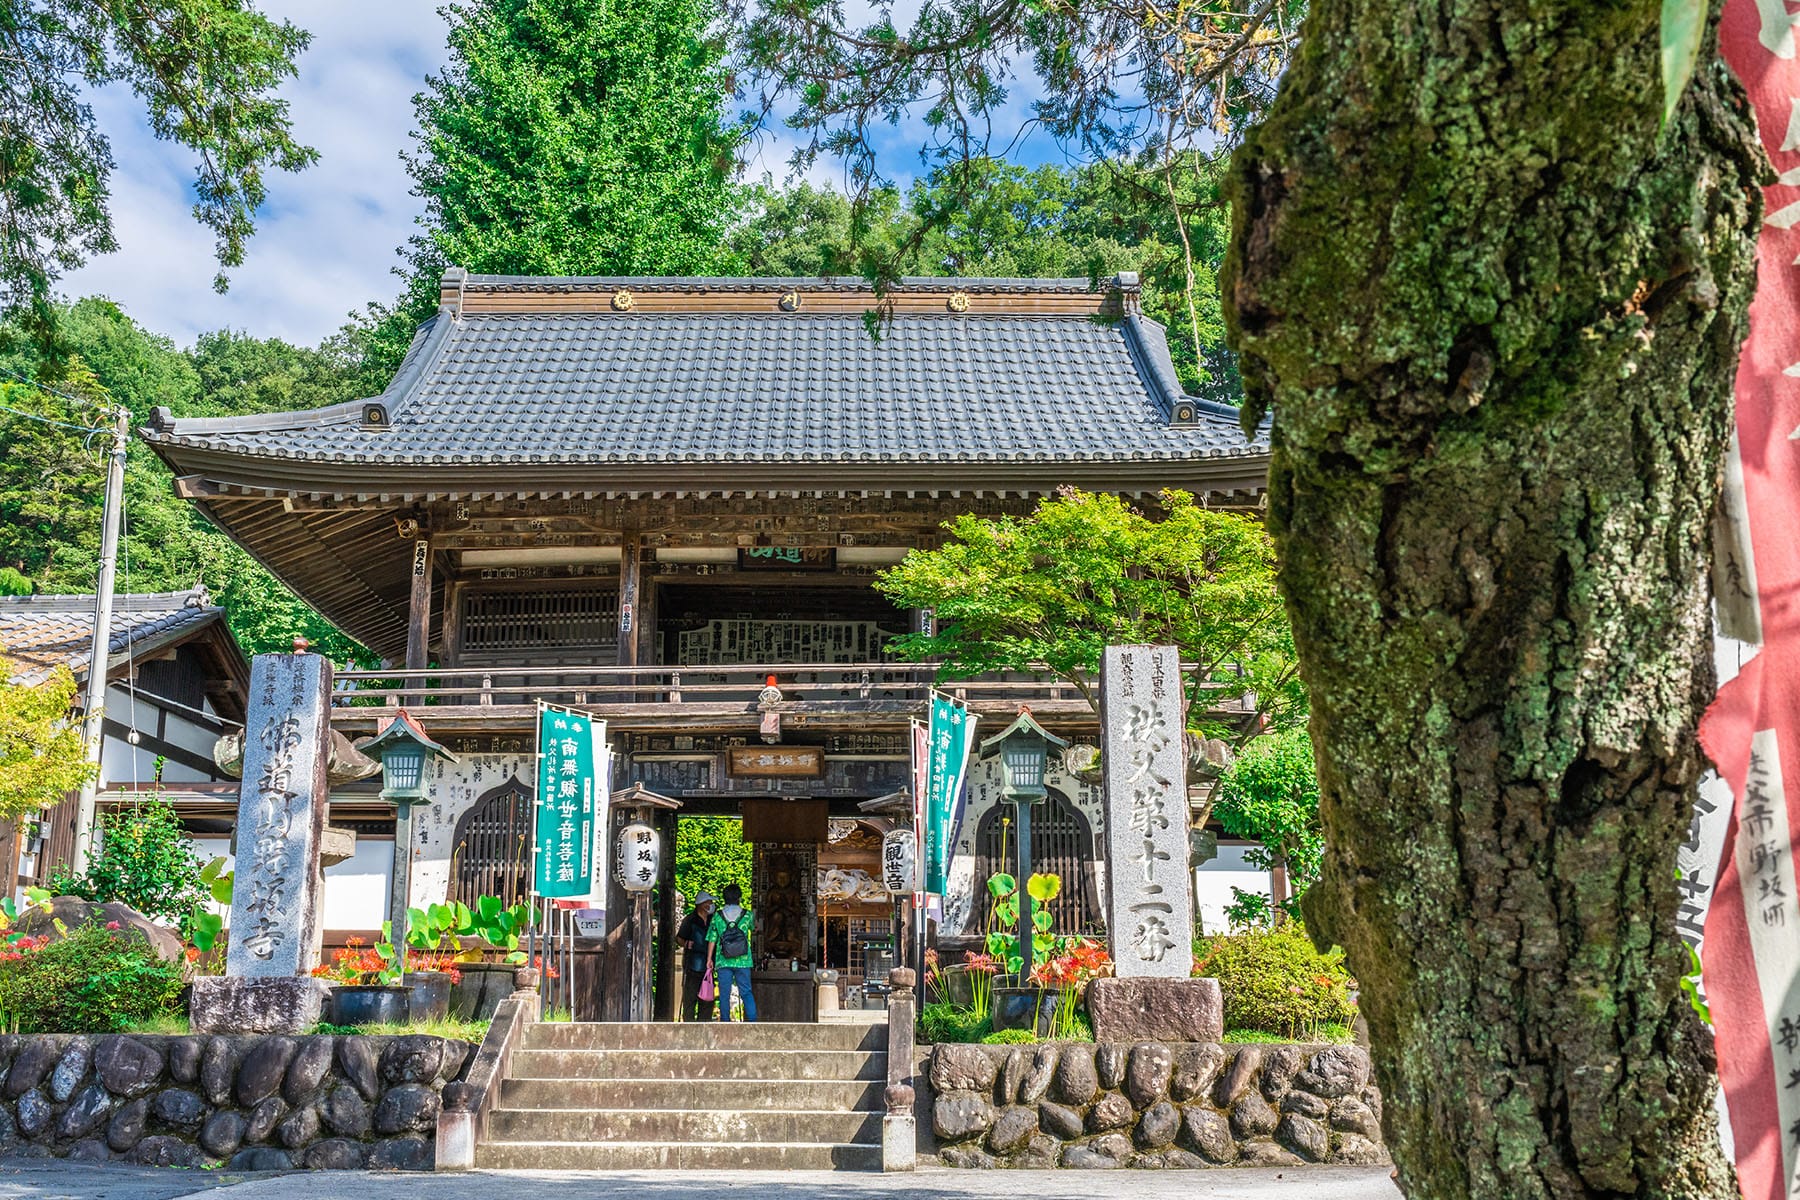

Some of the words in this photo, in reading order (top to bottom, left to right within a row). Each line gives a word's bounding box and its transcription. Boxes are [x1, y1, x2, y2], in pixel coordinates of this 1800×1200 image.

[636, 831, 653, 882] 野坂寺
[1120, 699, 1177, 963] 秩父第十二番
